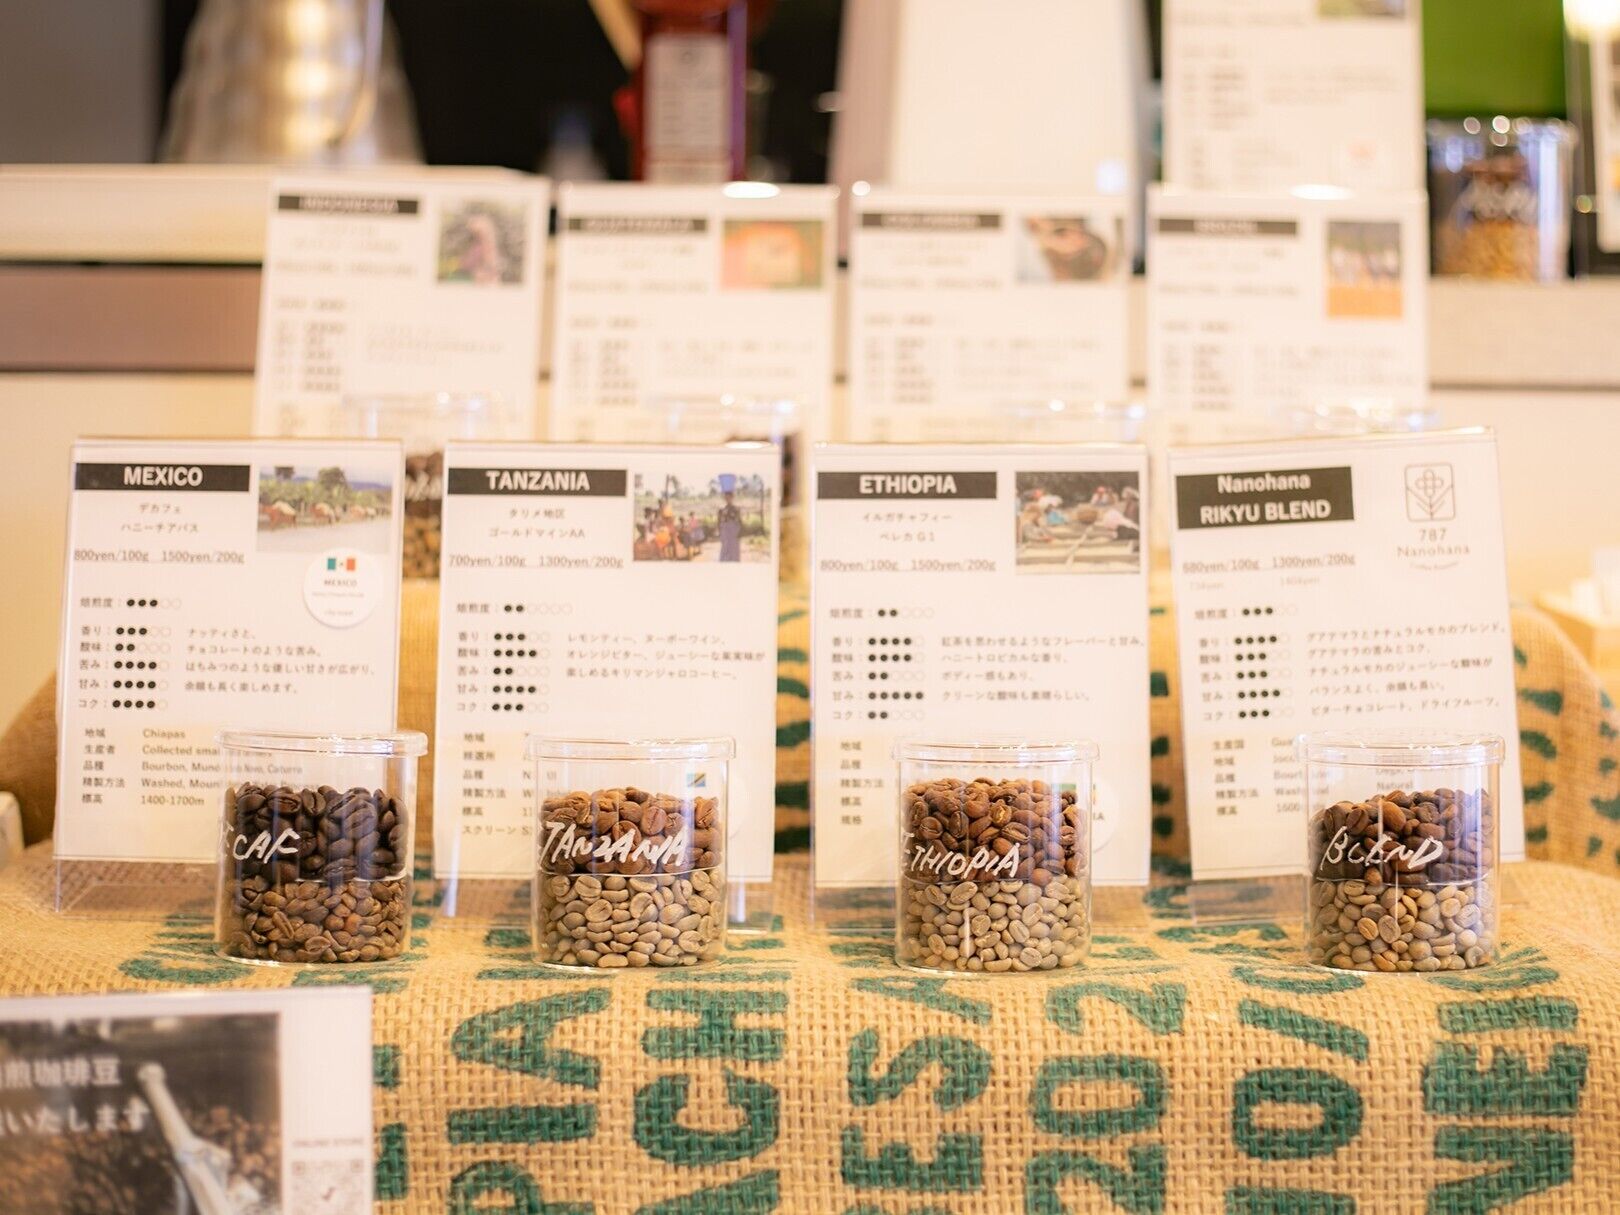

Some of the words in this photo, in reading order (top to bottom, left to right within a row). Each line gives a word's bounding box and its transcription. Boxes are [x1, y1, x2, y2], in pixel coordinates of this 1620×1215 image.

[123, 466, 203, 487] MEXICO
[485, 470, 591, 492] TANZANIA
[858, 474, 958, 495] ETHIOPIA
[1216, 472, 1312, 494] Nanohana
[139, 503, 182, 514] デカフェ
[509, 508, 566, 520] タリメ地区
[1199, 502, 1261, 525] RIKYU
[1264, 498, 1332, 521] BLEND
[1396, 544, 1471, 558] Nanohana
[73, 550, 150, 563] 800yen/100g
[162, 551, 246, 564] 1500yen/200g
[449, 555, 527, 569] 700yen/100g
[539, 555, 625, 569] 1300yen/200g
[820, 560, 900, 572] 800yen/100g
[911, 559, 997, 573] 1500yen/200g
[85, 728, 106, 738] 地域
[142, 729, 187, 740] Chiapas
[463, 732, 486, 743] 地域
[84, 745, 116, 756] 生産者
[142, 746, 193, 757] Collected
[840, 741, 862, 752] 地域
[82, 761, 105, 771] 品種
[141, 762, 187, 773] Bourbon,
[840, 759, 862, 770] 品種
[462, 770, 485, 781] 品種
[82, 777, 126, 788] 精製方法
[141, 778, 186, 789] Washed,
[81, 793, 103, 804] 標高
[140, 795, 205, 806] 1400-1700m
[461, 806, 484, 817] 標高
[462, 825, 517, 835] スクリーン
[540, 820, 691, 867] TANZANIA
[0, 1095, 150, 1136] いたします
